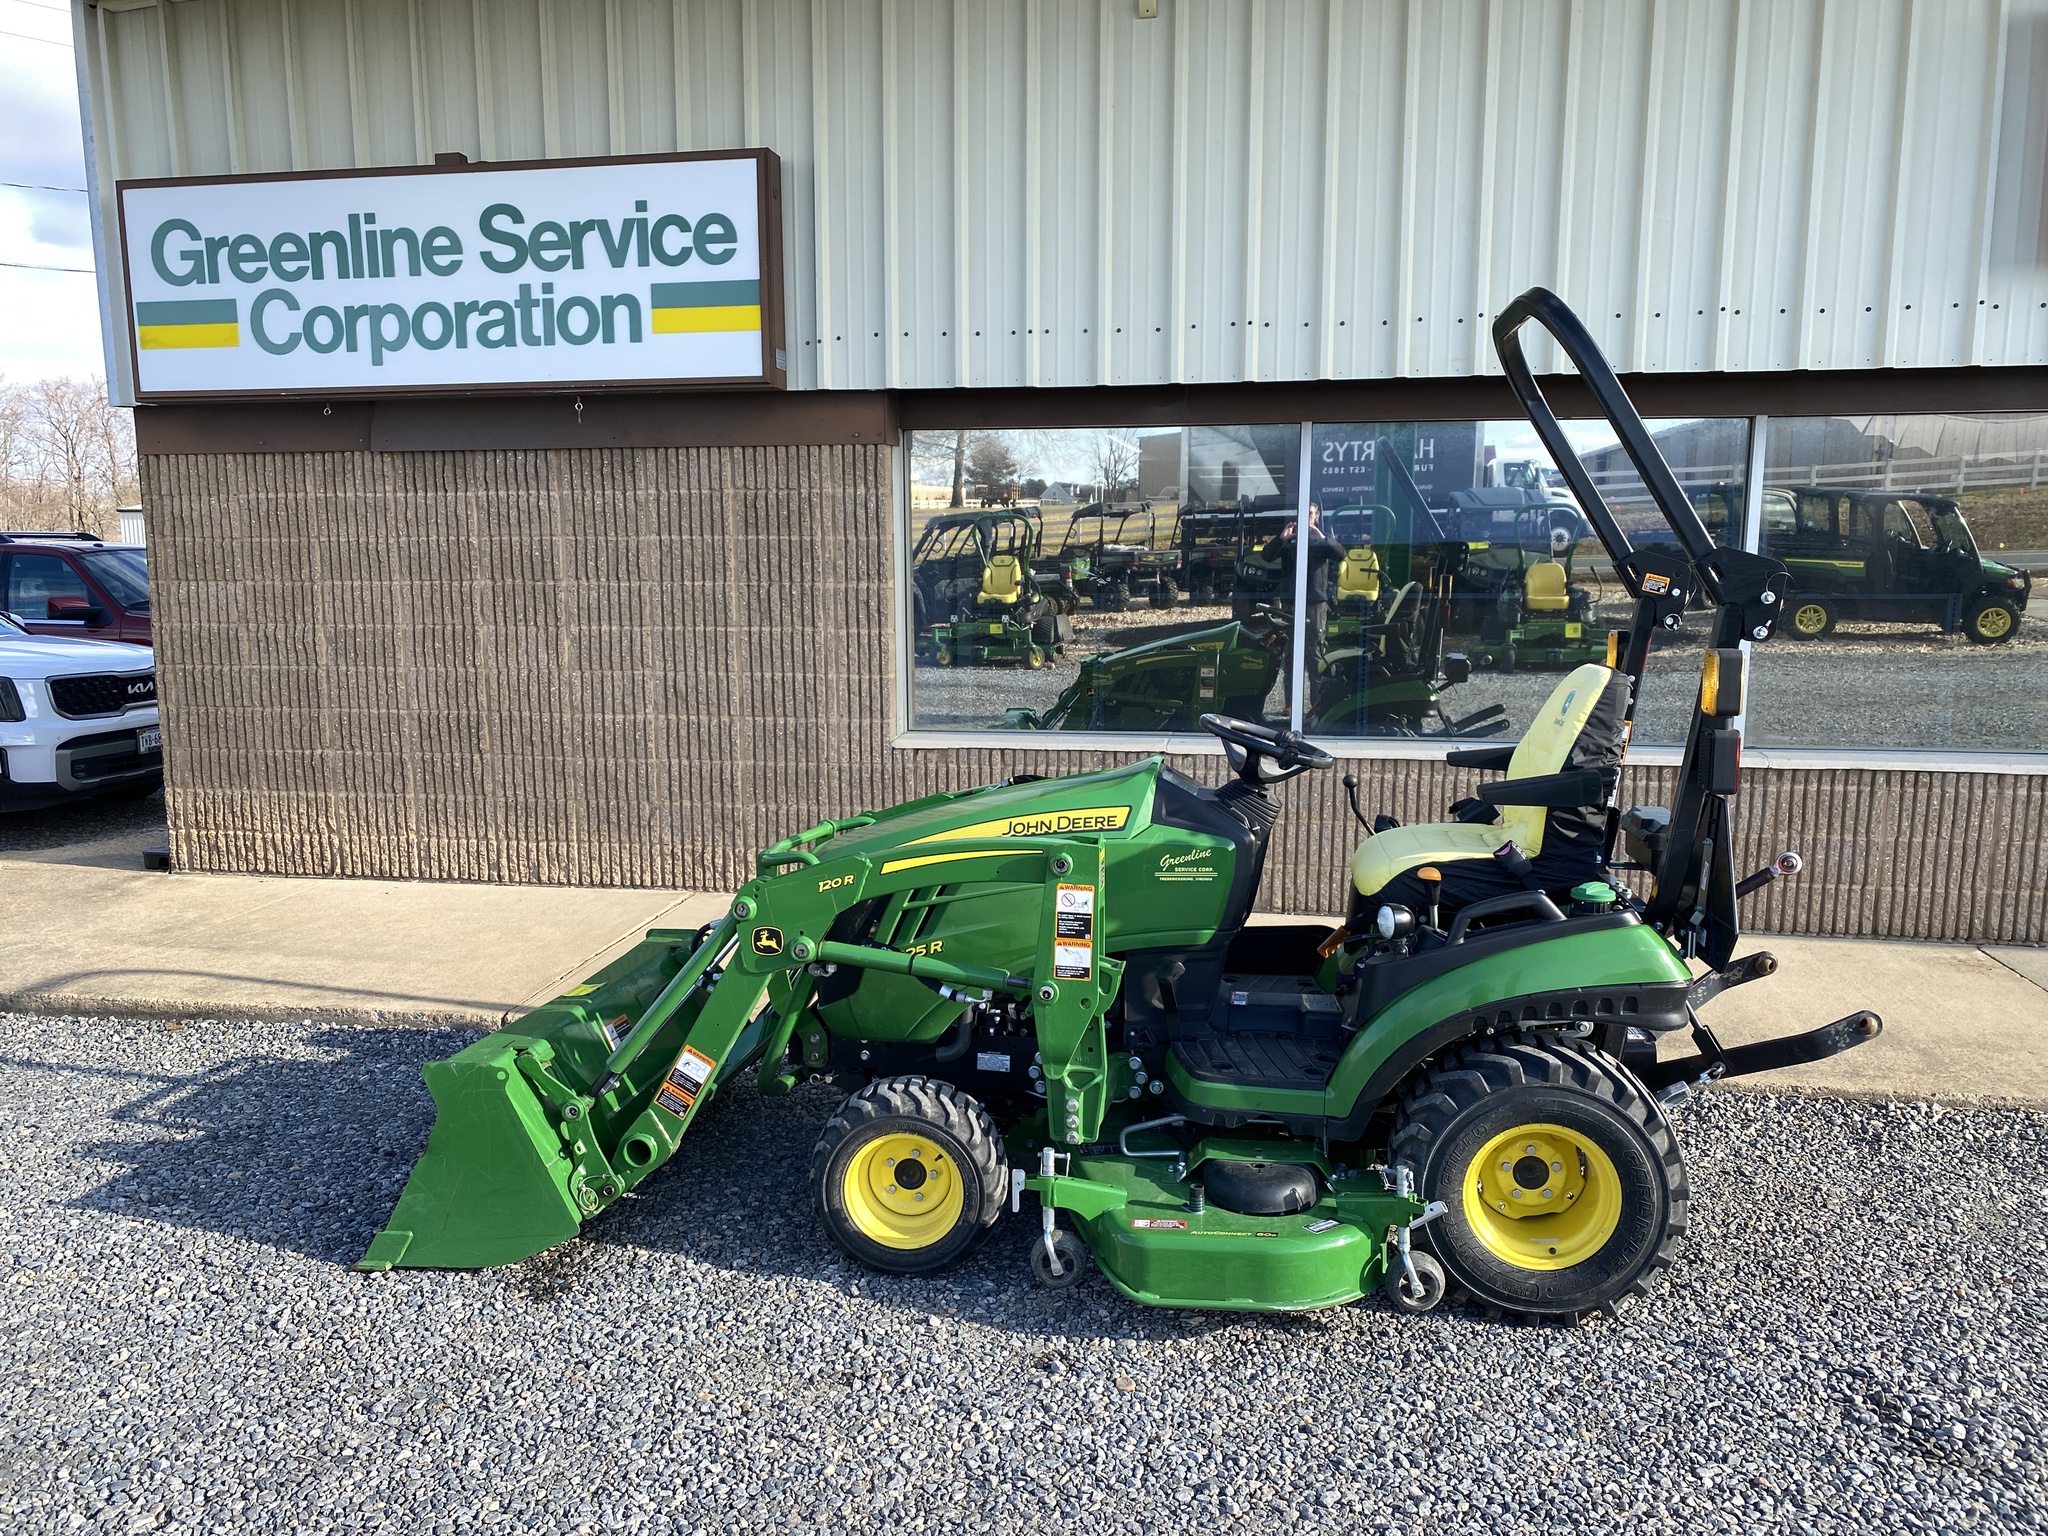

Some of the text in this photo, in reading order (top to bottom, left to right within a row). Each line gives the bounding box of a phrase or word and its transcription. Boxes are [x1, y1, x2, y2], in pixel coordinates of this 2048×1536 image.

[150, 199, 738, 287] Greenline Service
[249, 282, 643, 366] Corporation
[1002, 815, 1117, 836] JOHN DEERE
[1160, 849, 1212, 871] Greenline
[1611, 1149, 1653, 1273] CARLISLE
